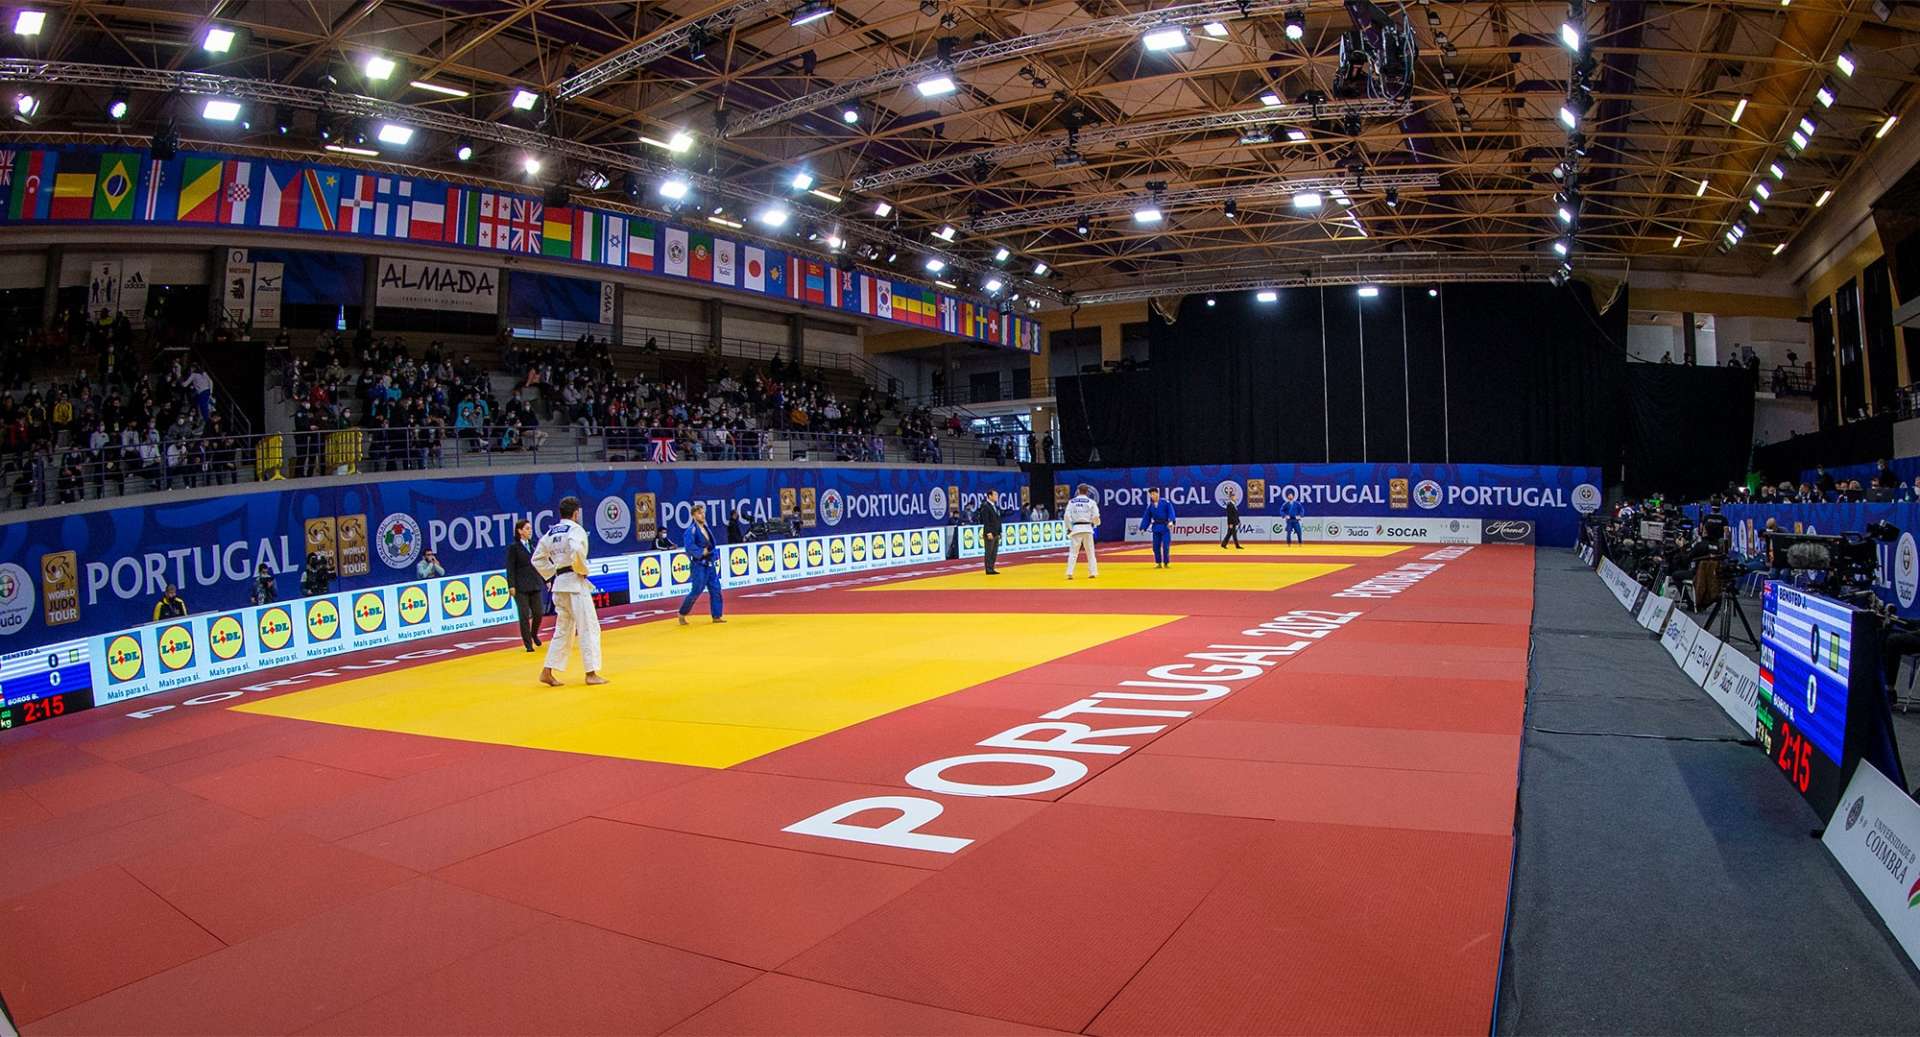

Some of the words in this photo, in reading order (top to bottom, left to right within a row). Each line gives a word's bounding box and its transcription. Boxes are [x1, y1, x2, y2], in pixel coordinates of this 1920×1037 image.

[381, 263, 494, 295] ALMADA
[1269, 484, 1385, 504] PORTUGAL
[1448, 485, 1567, 508] PORTUGAL
[847, 493, 927, 518] PORTUGAL
[605, 529, 622, 539] Judo
[1172, 523, 1219, 536] impulse
[1347, 528, 1369, 537] Judo
[1387, 527, 1427, 537] SOCAR
[343, 546, 366, 555] WORLD
[343, 554, 366, 565] JUDO
[86, 535, 299, 605] PORTUGAL
[343, 563, 367, 574] TOUR
[601, 564, 609, 574] 0
[48, 589, 76, 600] WORLD
[1779, 587, 1802, 608] BENSTED
[48, 599, 76, 613] JUDO
[0, 613, 22, 628] udo
[48, 610, 78, 622] TOUR
[413, 630, 426, 638] para
[353, 640, 368, 648] Mais
[369, 638, 383, 646] para
[1811, 623, 1820, 665] 0
[307, 648, 323, 657] Mais
[323, 646, 337, 655] para
[48, 653, 59, 669] 0
[259, 658, 275, 667] Mais
[275, 655, 290, 664] para
[209, 668, 226, 677] Mais
[227, 665, 241, 675] para
[50, 671, 61, 686] 0
[159, 679, 176, 688] Mais
[176, 677, 192, 686] para
[107, 690, 124, 700] Mais
[125, 688, 141, 697] para
[1806, 674, 1818, 714] 0
[24, 694, 65, 722] 2:15
[0, 719, 12, 729] kg
[781, 641, 1312, 853] PORTUGAL
[1241, 610, 1364, 639] 2022
[1778, 722, 1813, 793] 2:15
[1874, 816, 1911, 859] UNIVERSIDADE
[1866, 830, 1908, 884] COIMBRA
